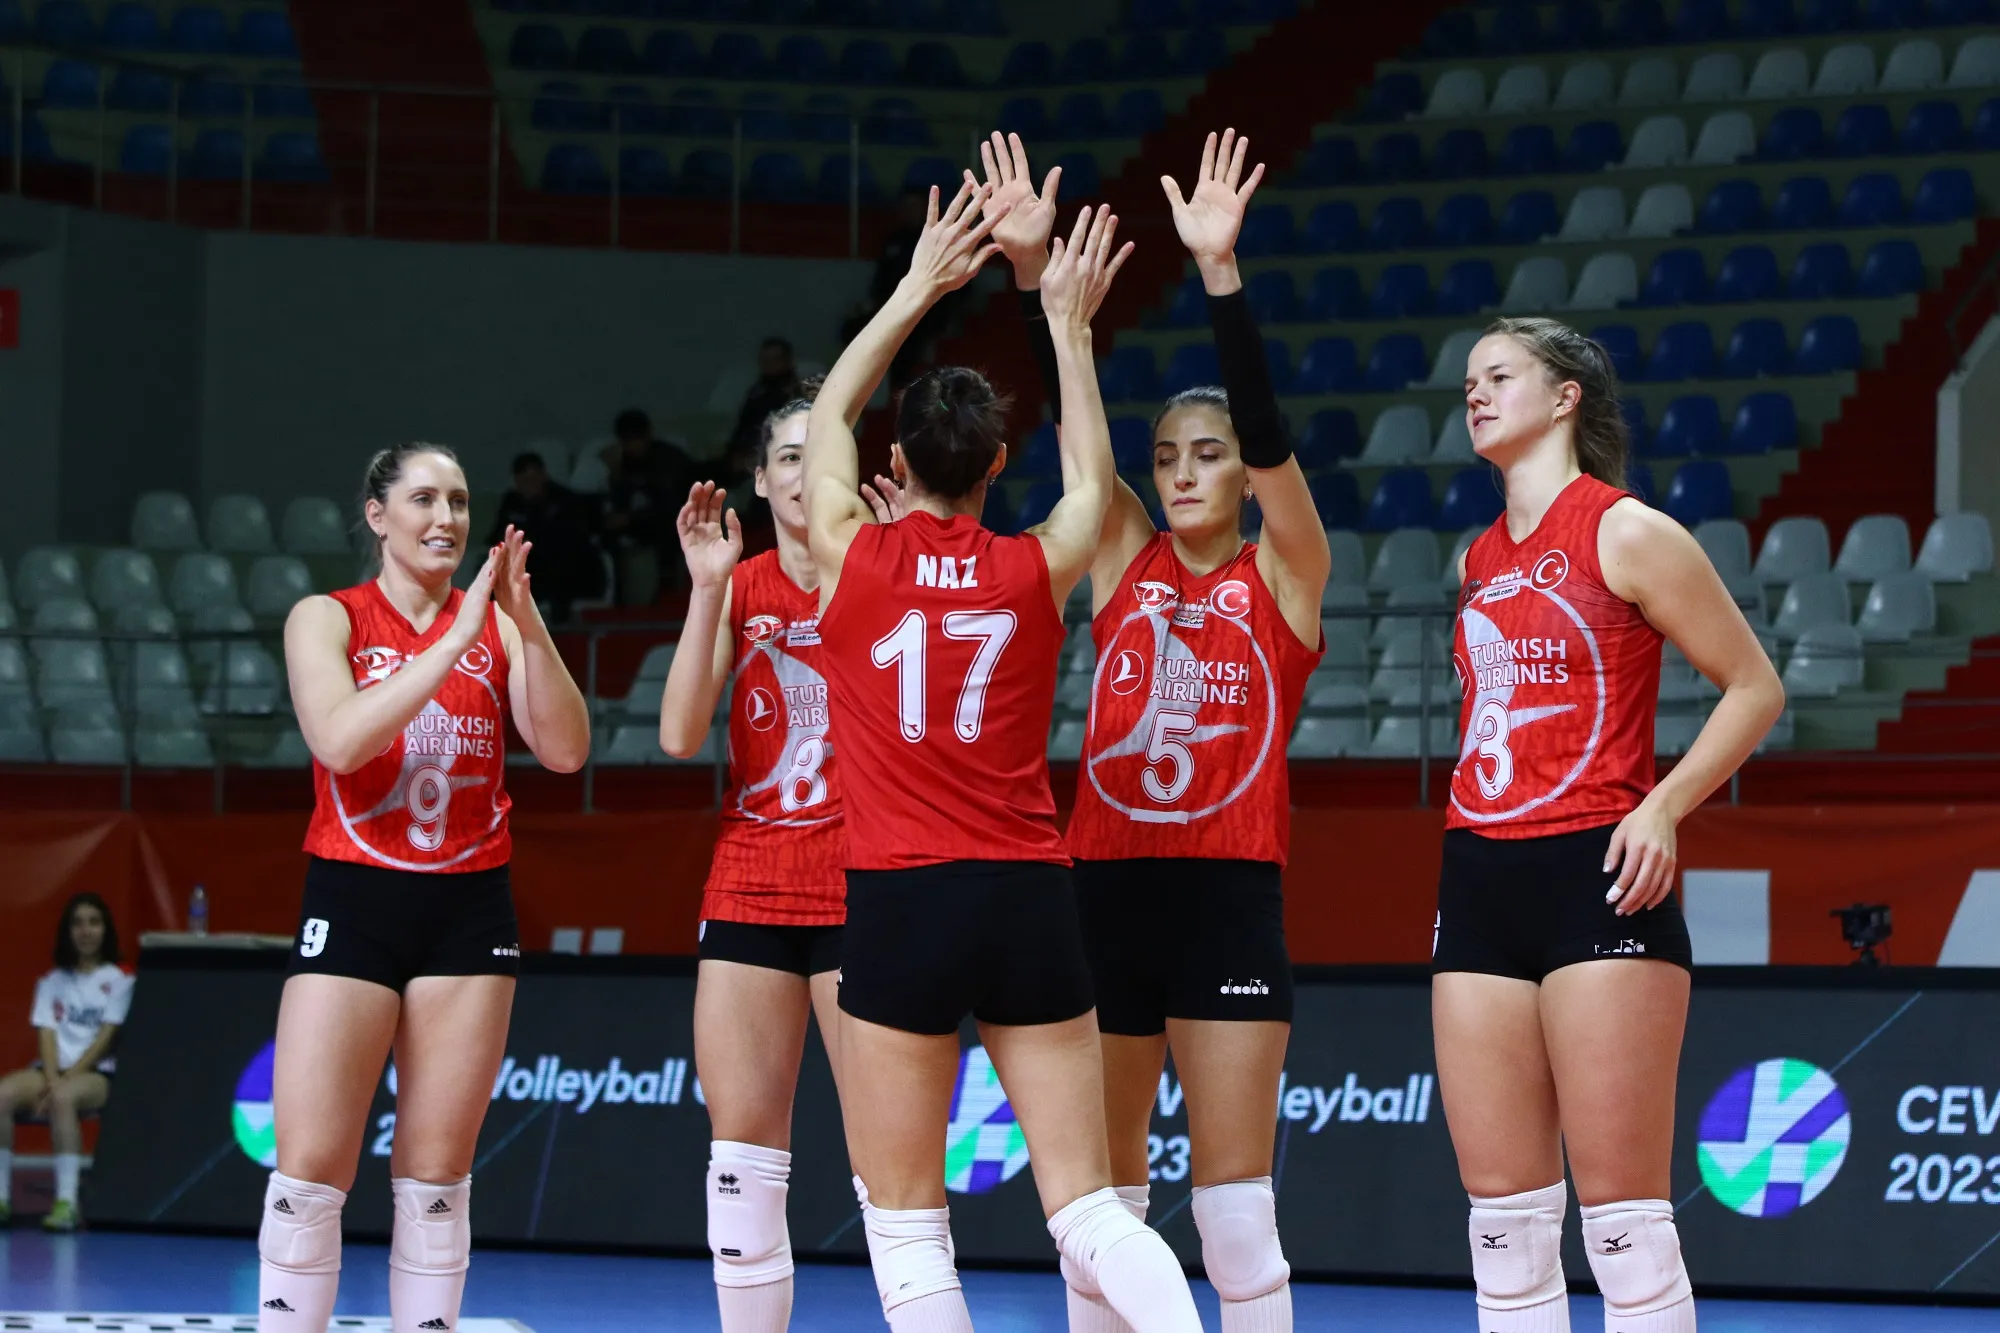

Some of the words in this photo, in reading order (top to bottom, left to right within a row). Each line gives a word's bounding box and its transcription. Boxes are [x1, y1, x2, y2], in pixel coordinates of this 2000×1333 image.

[915, 553, 979, 589] NAZ
[1156, 655, 1250, 683] TURKISH
[1470, 637, 1567, 667] TURKISH
[870, 608, 1018, 743] 17
[1149, 678, 1248, 706] AIRLINES
[1475, 662, 1569, 693] AIRLINES
[408, 714, 495, 737] TURKISH
[404, 736, 494, 759] AIRLINES
[1140, 708, 1197, 804] 5
[1474, 698, 1514, 800] 3
[778, 734, 828, 813] 8
[406, 764, 453, 852] 9
[300, 917, 330, 958] 9
[1220, 978, 1269, 995] diadora
[1896, 1085, 2000, 1135] CEV
[1147, 1134, 1191, 1182] 23
[1884, 1152, 2000, 1204] 2023
